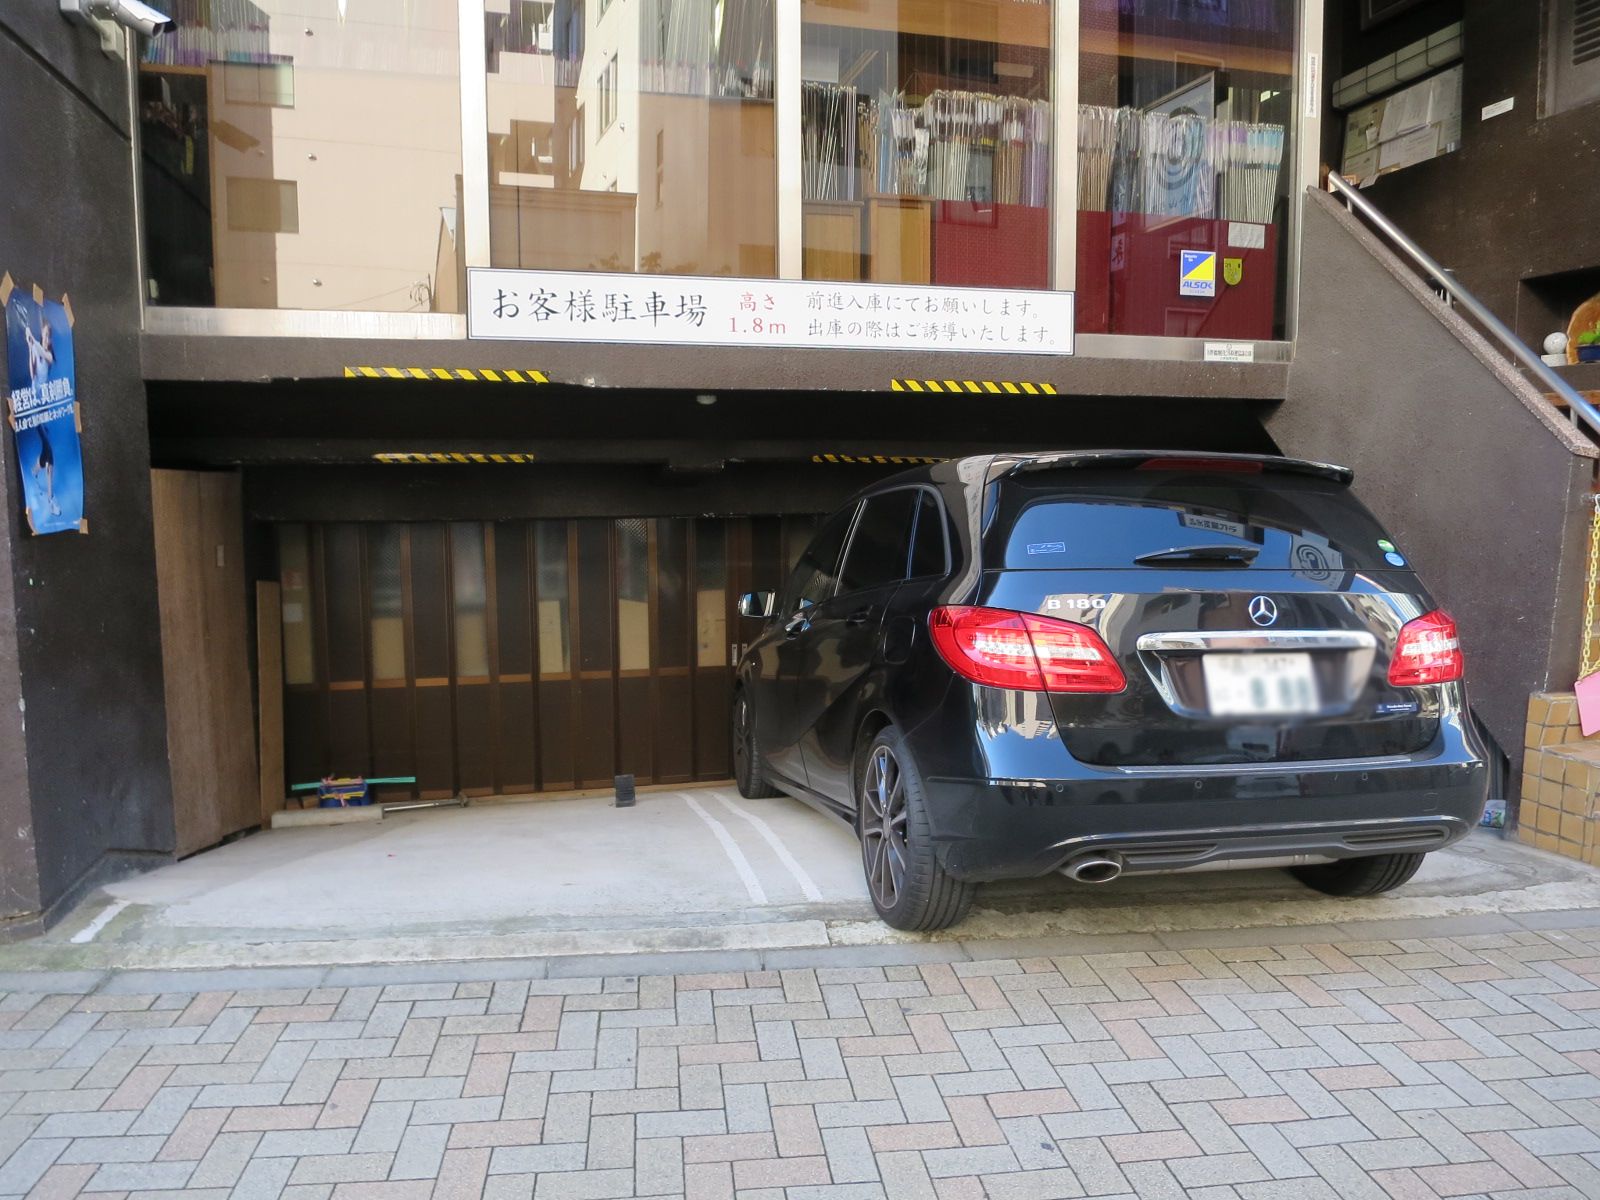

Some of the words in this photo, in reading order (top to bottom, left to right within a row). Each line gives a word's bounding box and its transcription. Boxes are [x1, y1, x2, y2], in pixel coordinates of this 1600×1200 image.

[1182, 280, 1213, 290] ALSOK
[492, 287, 708, 328] お客様駐車場
[739, 292, 775, 312] 高さ
[806, 291, 1038, 319] 前進入庫にてお願いします。
[728, 316, 787, 335] 1.8m
[807, 318, 1055, 345] 出庫の際はご誘導いたします。
[1047, 599, 1061, 610] B
[1066, 598, 1106, 609] 180
